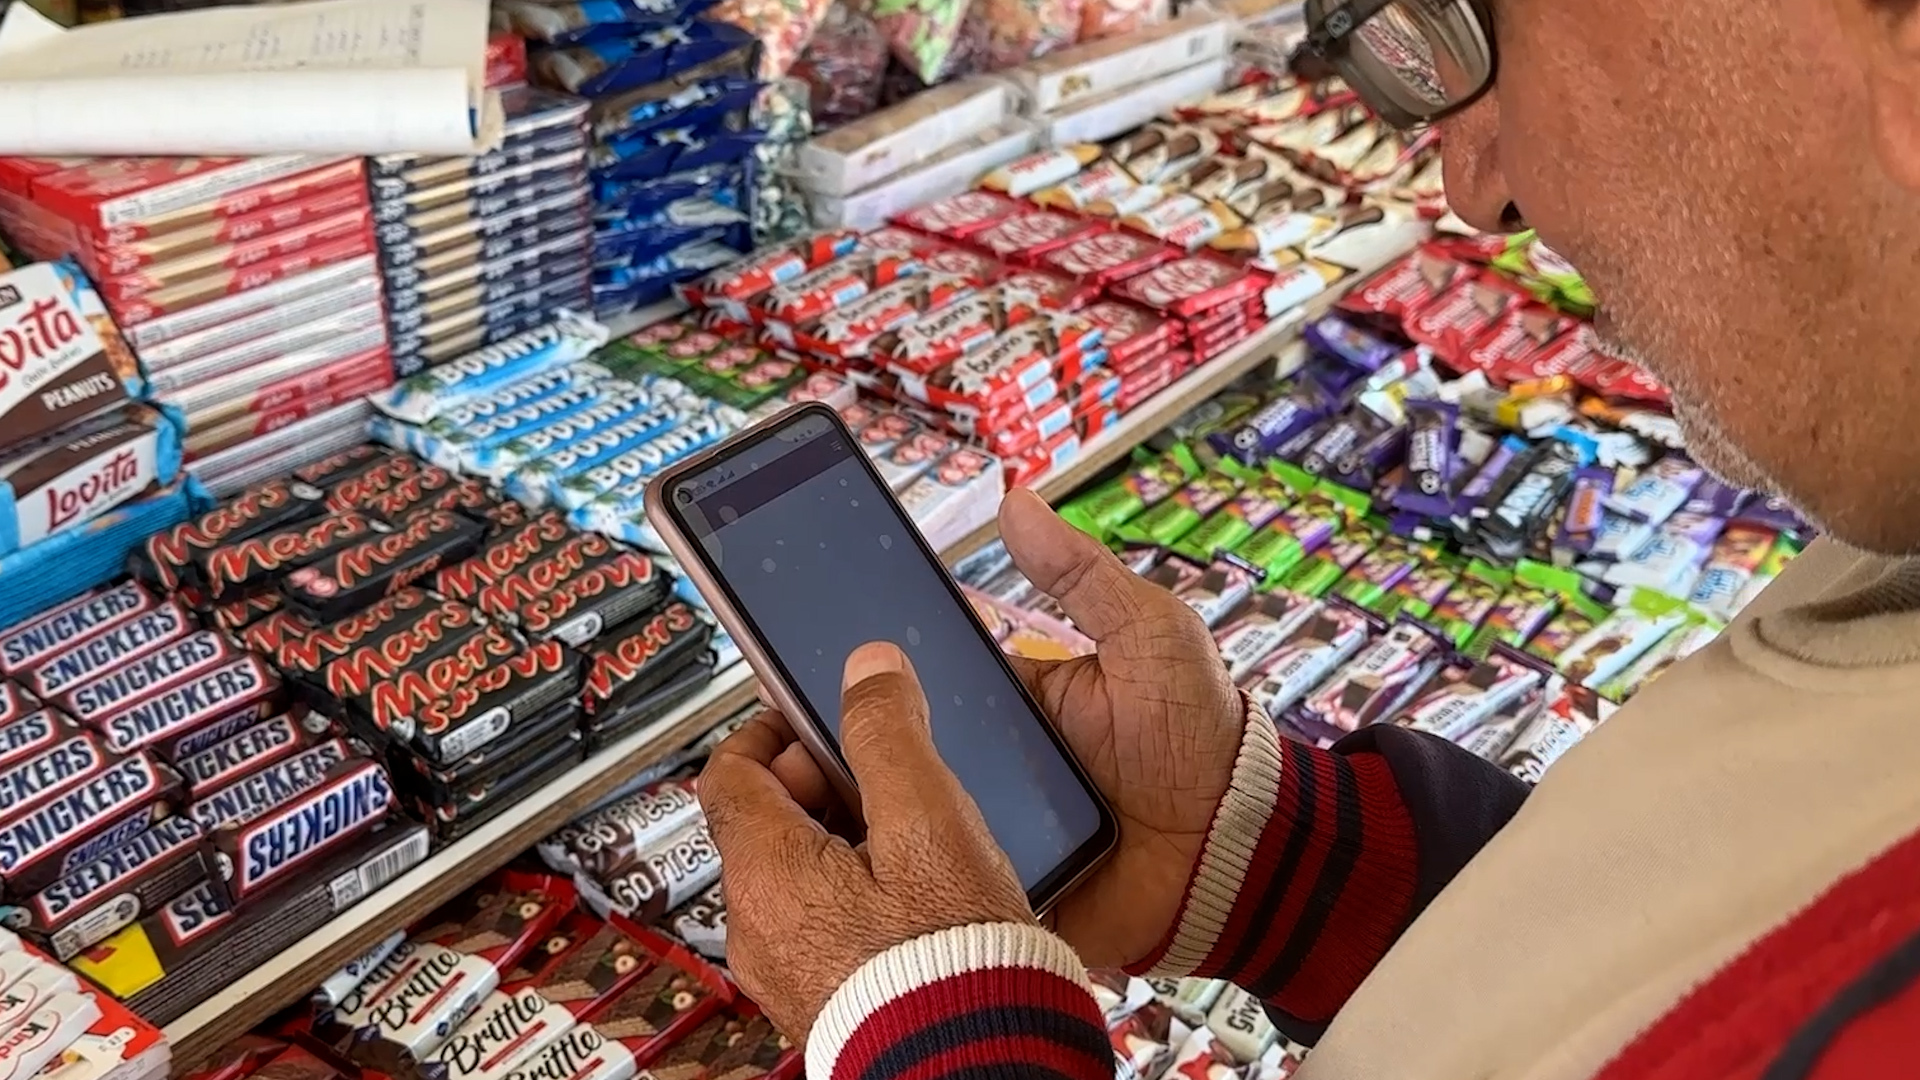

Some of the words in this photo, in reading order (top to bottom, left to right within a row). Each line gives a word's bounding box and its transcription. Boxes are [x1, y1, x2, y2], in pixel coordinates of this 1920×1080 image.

[41, 371, 117, 411] PEANUTS
[430, 320, 563, 386] BOUNTY
[450, 365, 573, 427] BOUNTY
[471, 381, 602, 440] BOUNTY
[522, 383, 650, 451] BOUNTY
[548, 401, 678, 469] BOUNTY
[47, 447, 138, 533] Lovita
[587, 410, 724, 490] BOUNTY
[146, 478, 291, 591] Mars
[207, 511, 368, 600] Mars
[335, 507, 456, 591] Mars
[436, 510, 567, 601] Mars
[479, 531, 610, 618] Mars
[3, 582, 142, 665] SNICKERS
[40, 604, 178, 694] SNICKERS
[279, 586, 424, 672] Mars
[327, 599, 472, 698] Mars
[580, 600, 695, 701] Mars
[75, 632, 216, 716] SNICKERS
[110, 662, 257, 749] SNICKERS
[371, 622, 515, 733] Mars
[0, 739, 93, 810] CKERS
[0, 757, 149, 871] SNICKERS
[197, 747, 340, 832] SNICKERS
[248, 764, 389, 883] SNICKERS
[650, 831, 719, 888] Fres
[368, 949, 461, 1032] Brittle
[439, 991, 545, 1076] Brittle
